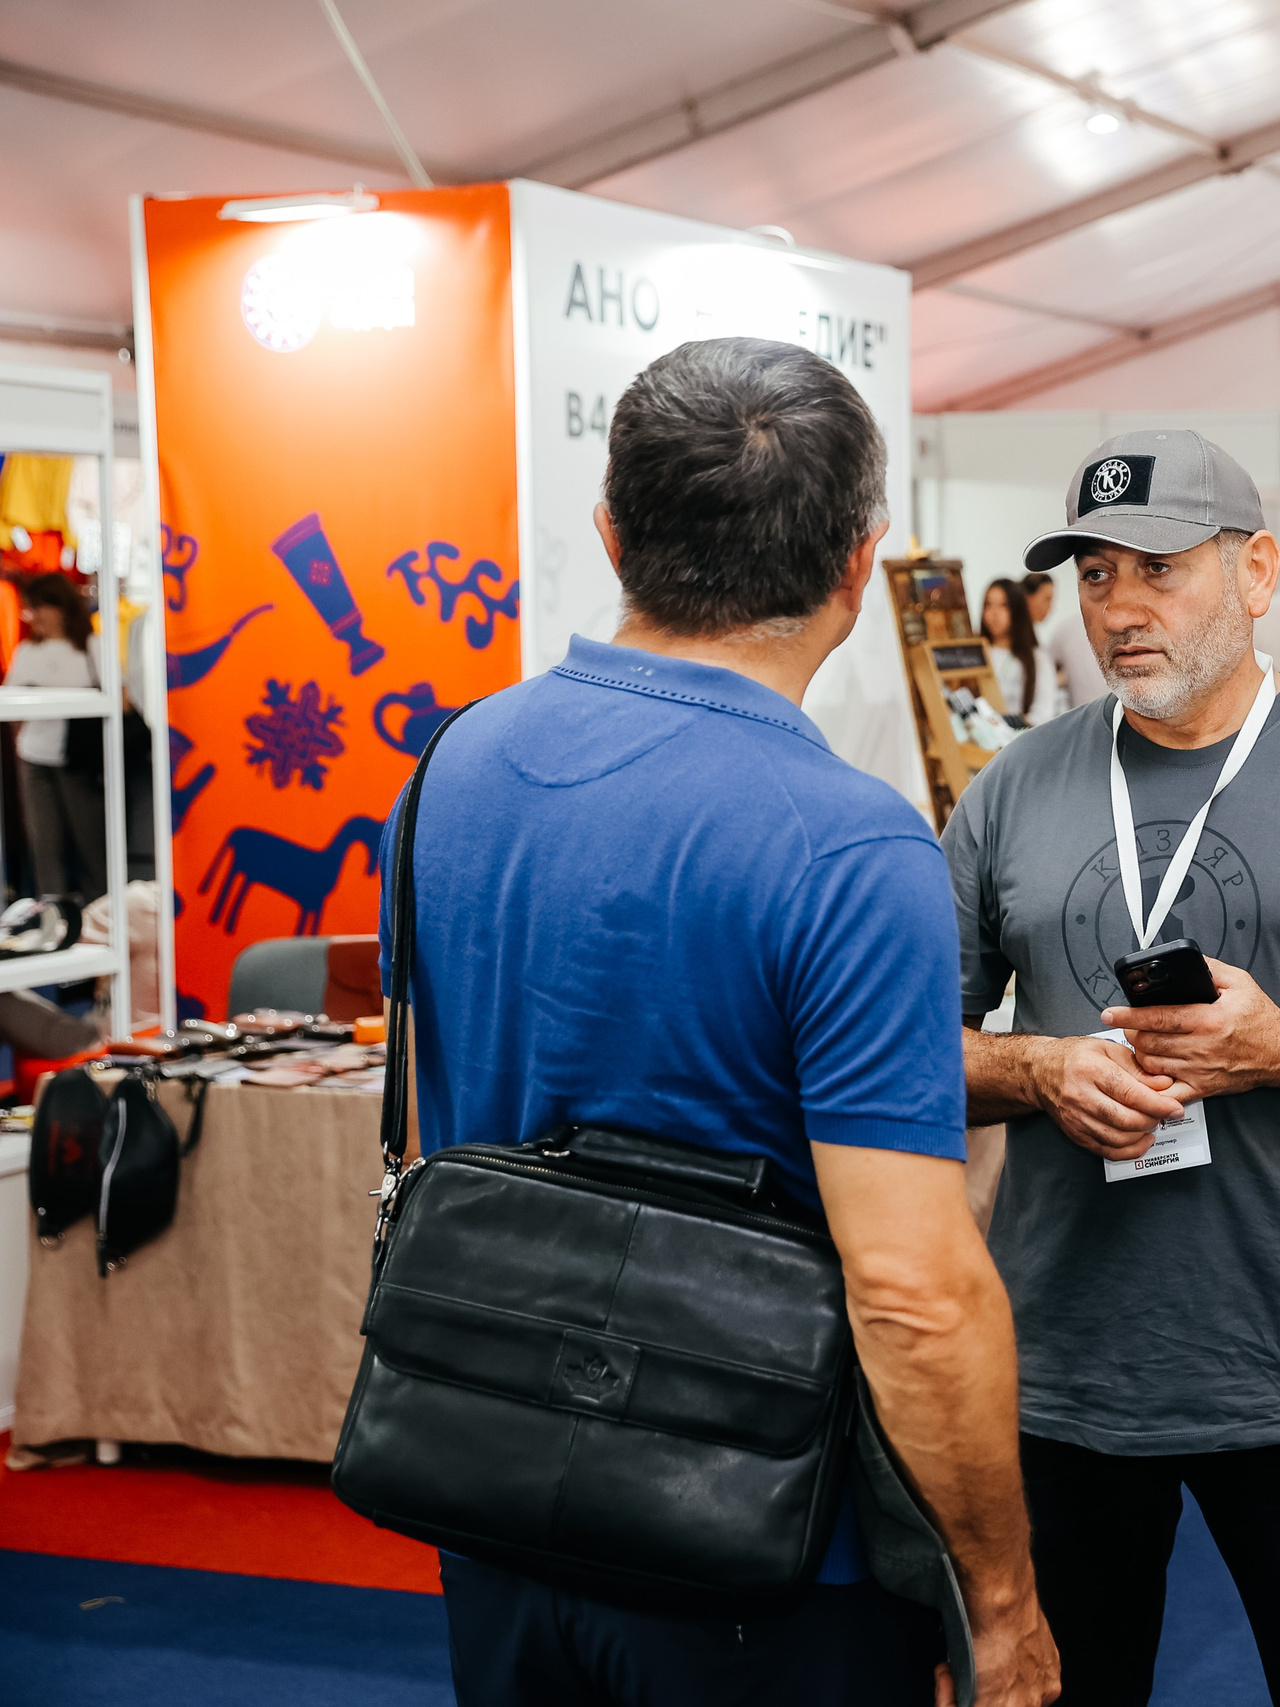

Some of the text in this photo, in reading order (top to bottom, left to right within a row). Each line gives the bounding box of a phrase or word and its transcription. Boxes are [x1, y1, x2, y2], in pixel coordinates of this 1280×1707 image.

[565, 261, 660, 332] АНО
[1144, 1152, 1179, 1163] УНИВЕРСИТЕТ
[1144, 1156, 1180, 1169] СИНЕРГИЯ
